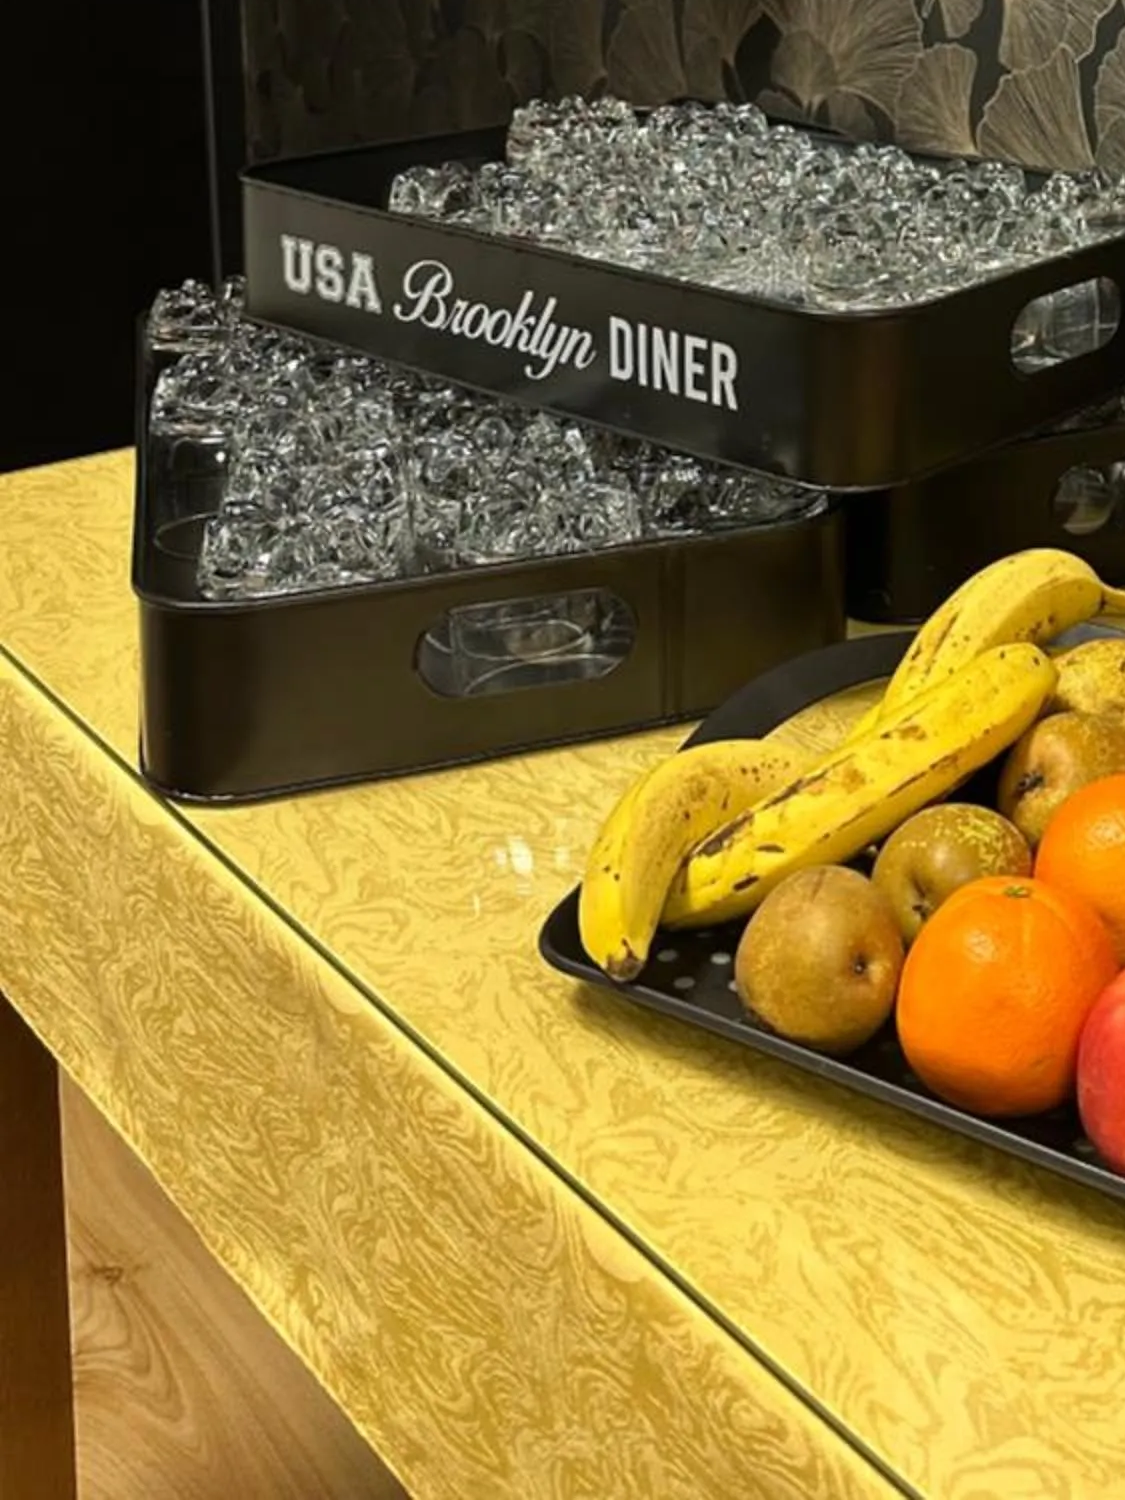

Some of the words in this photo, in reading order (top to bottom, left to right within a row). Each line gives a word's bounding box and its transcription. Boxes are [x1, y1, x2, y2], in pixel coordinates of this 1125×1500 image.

[281, 234, 383, 314] USA
[393, 259, 596, 380] Brooklyn
[609, 316, 739, 411] DINER
